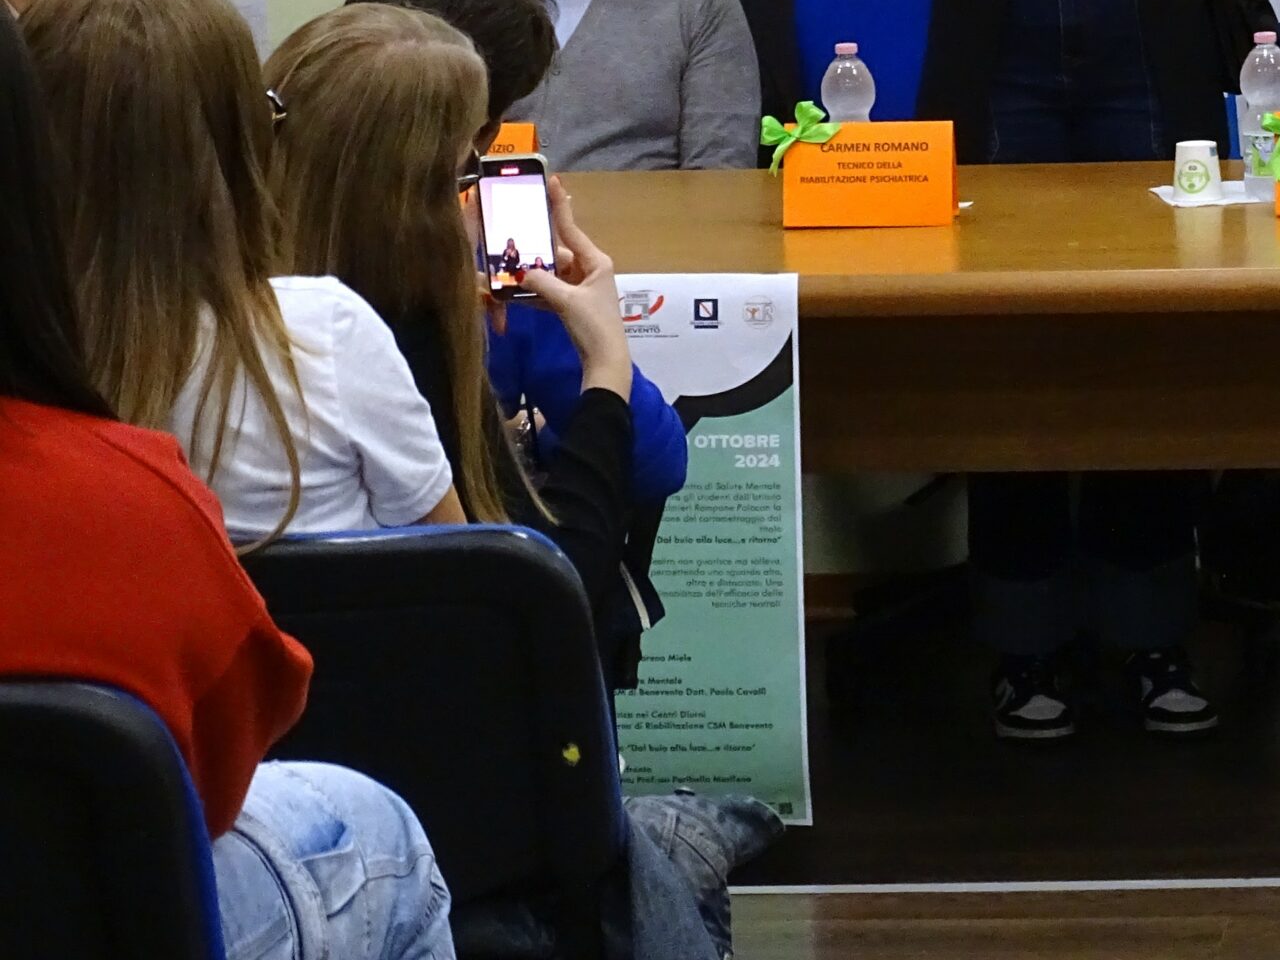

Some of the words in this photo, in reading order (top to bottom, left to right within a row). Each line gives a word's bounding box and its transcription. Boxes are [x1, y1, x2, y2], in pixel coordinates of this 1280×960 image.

[820, 142, 871, 153] CARMEN
[874, 141, 929, 152] ROMANO
[837, 161, 874, 170] TECNICO
[876, 161, 903, 169] DELLA
[800, 175, 867, 184] RIABILITAZIONE
[870, 174, 929, 183] PSICHIATRICA
[694, 434, 780, 448] OTTOBRE
[734, 453, 781, 468] 2024
